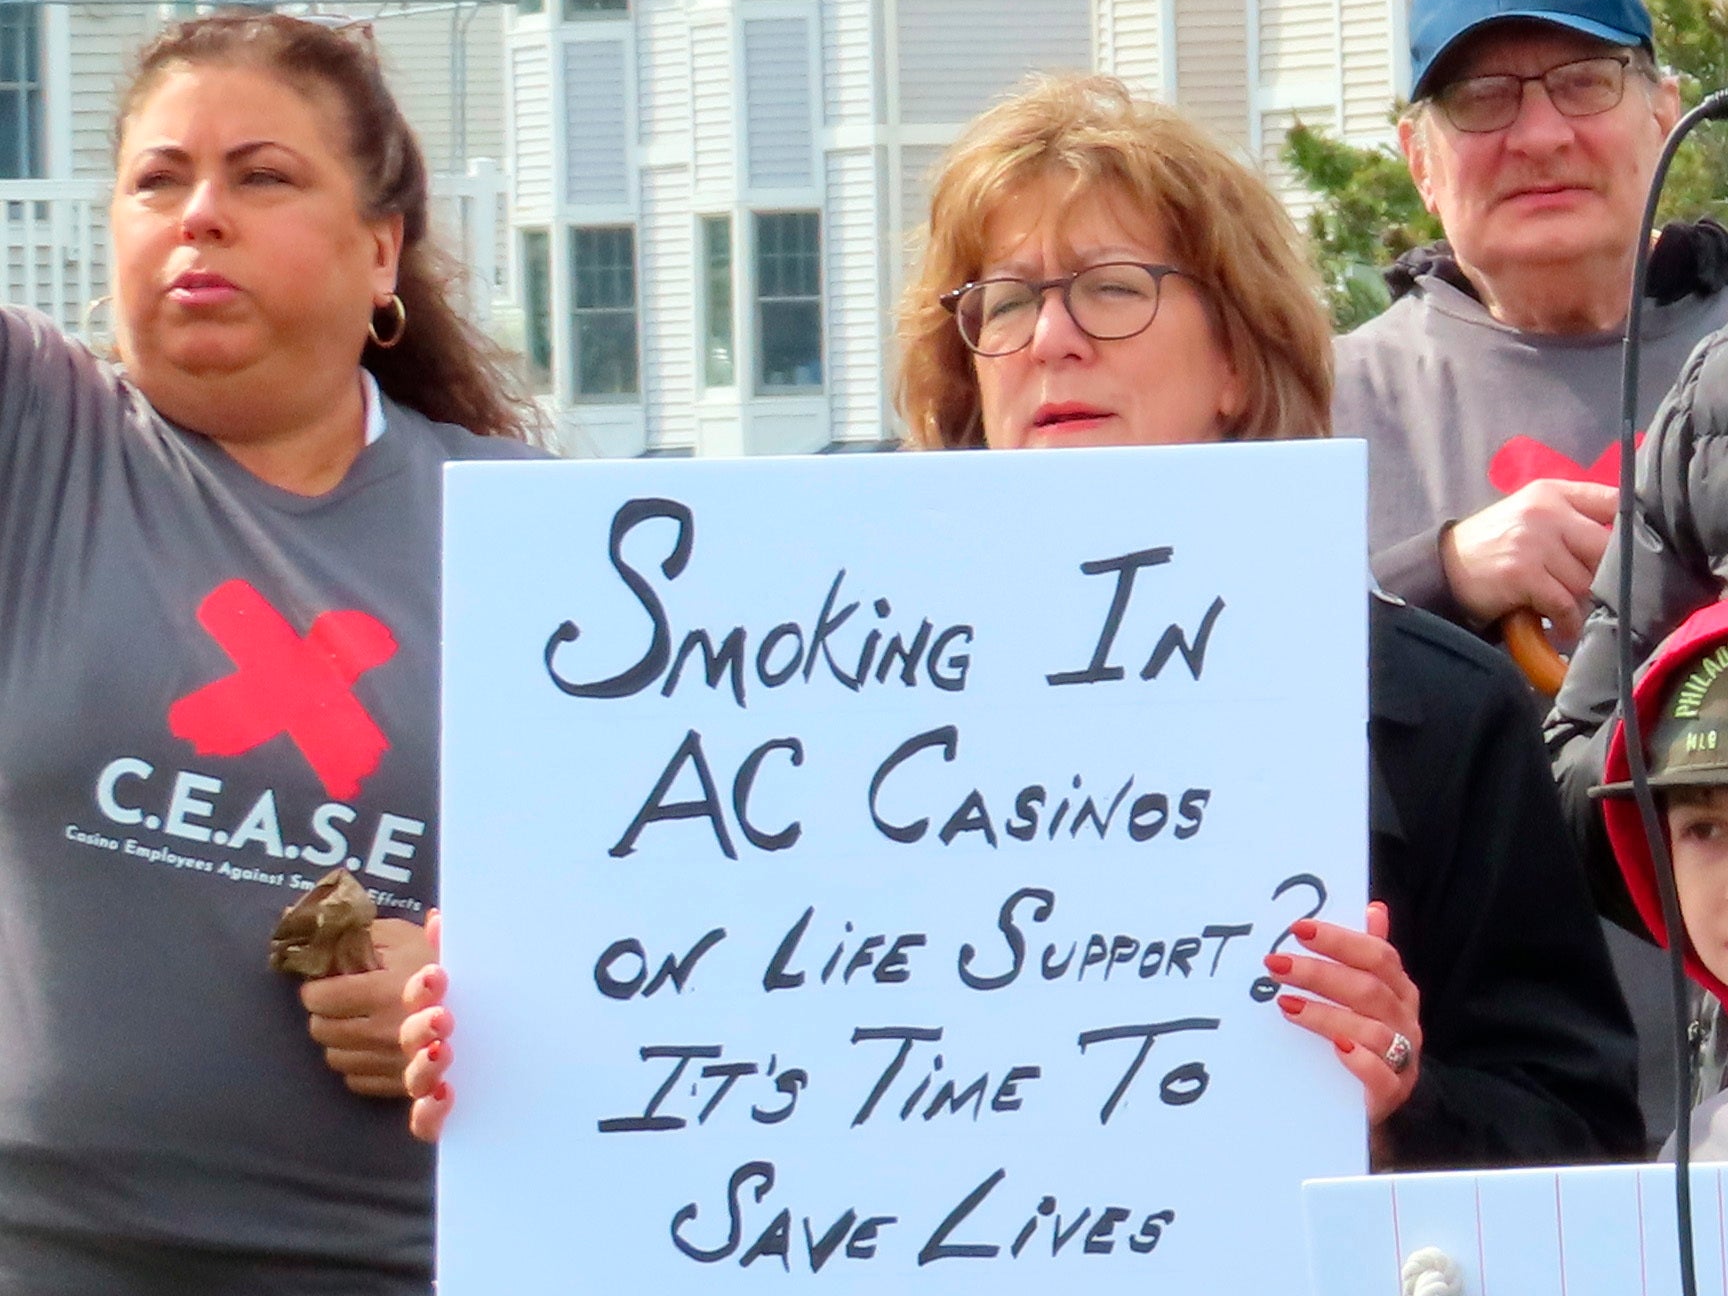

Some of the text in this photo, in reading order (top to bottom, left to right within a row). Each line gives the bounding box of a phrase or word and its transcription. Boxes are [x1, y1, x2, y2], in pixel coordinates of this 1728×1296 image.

[543, 497, 1227, 709] SMOKING IN
[95, 756, 426, 885] C.E.A.S.E
[607, 724, 1212, 862] AC CASINOS
[64, 824, 119, 851] Casino
[122, 839, 214, 873] Employees
[216, 861, 285, 887] Against
[367, 888, 423, 912] Effects
[593, 927, 727, 1002] ON
[763, 906, 927, 992] LIFE
[597, 1017, 1221, 1134] IT'S TIME TO
[670, 1160, 1176, 1273] SAVE LIVES
